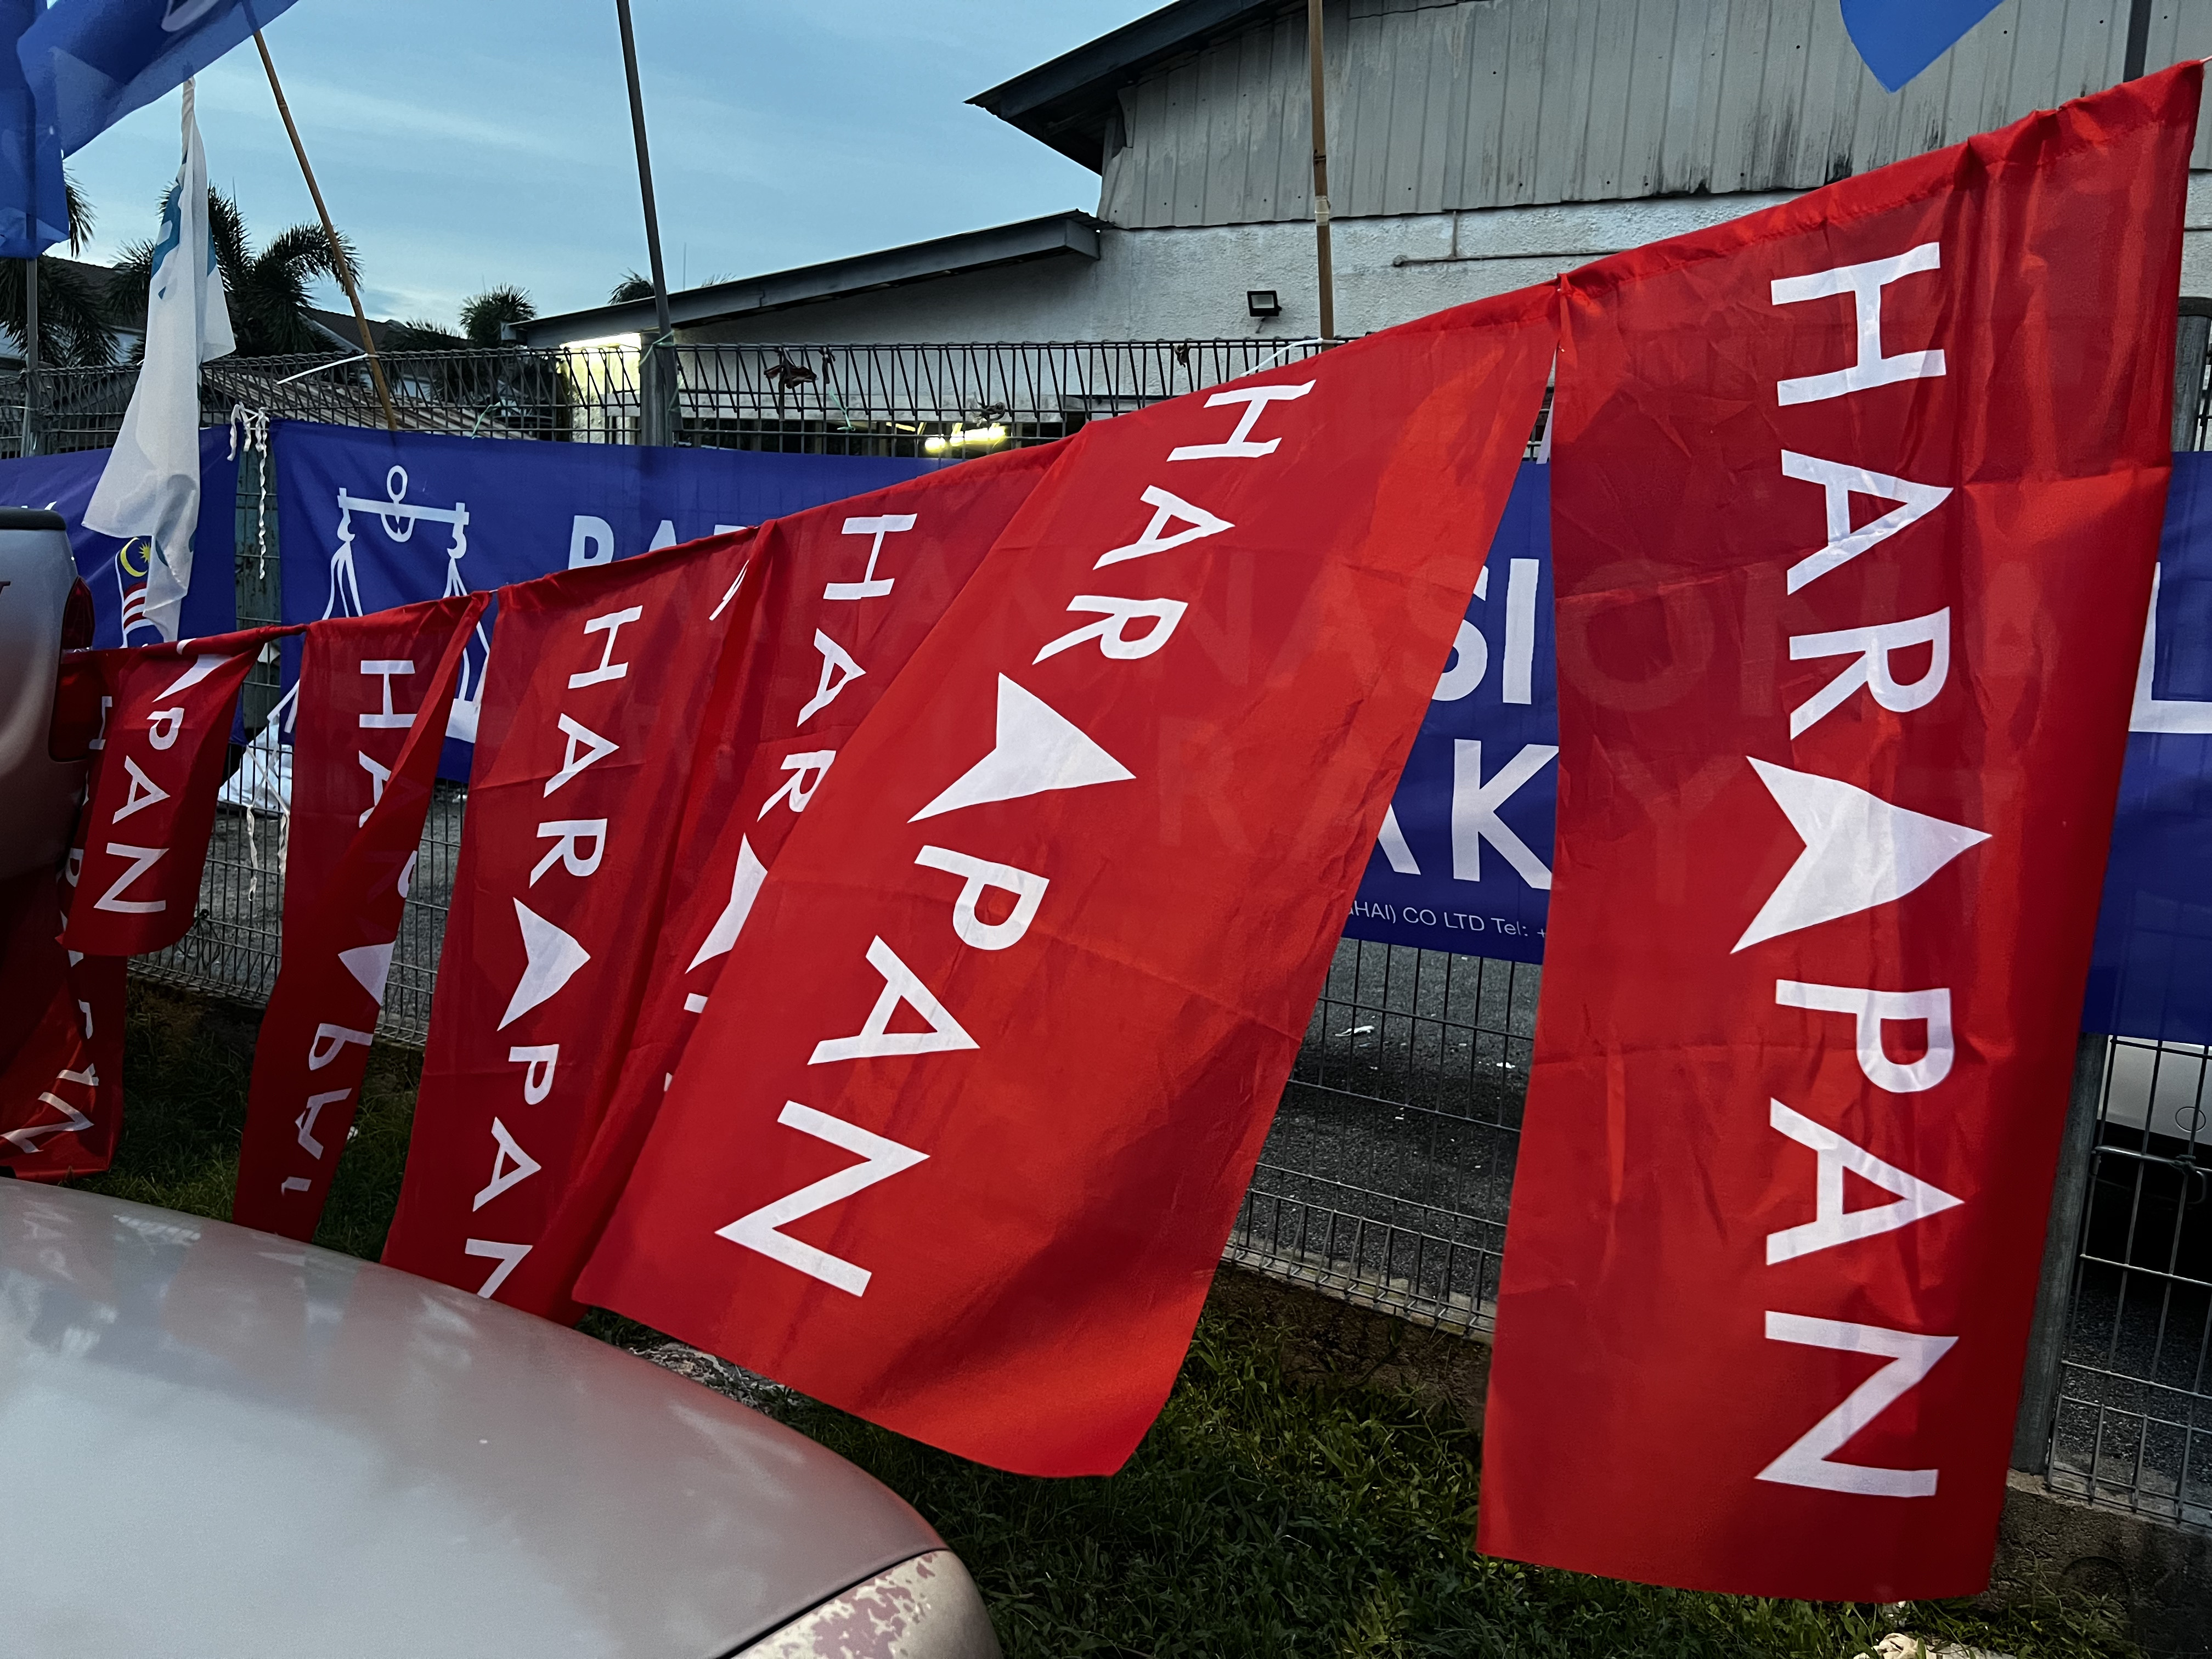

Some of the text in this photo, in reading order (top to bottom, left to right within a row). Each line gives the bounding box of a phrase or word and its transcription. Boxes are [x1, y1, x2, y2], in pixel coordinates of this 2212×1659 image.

[715, 379, 1315, 1296] HARAPAN
[1403, 907, 1436, 926] CO
[1443, 912, 1485, 931] LTD
[1491, 917, 1528, 936] Tel:
[1730, 241, 1993, 1497] HARAPAN
